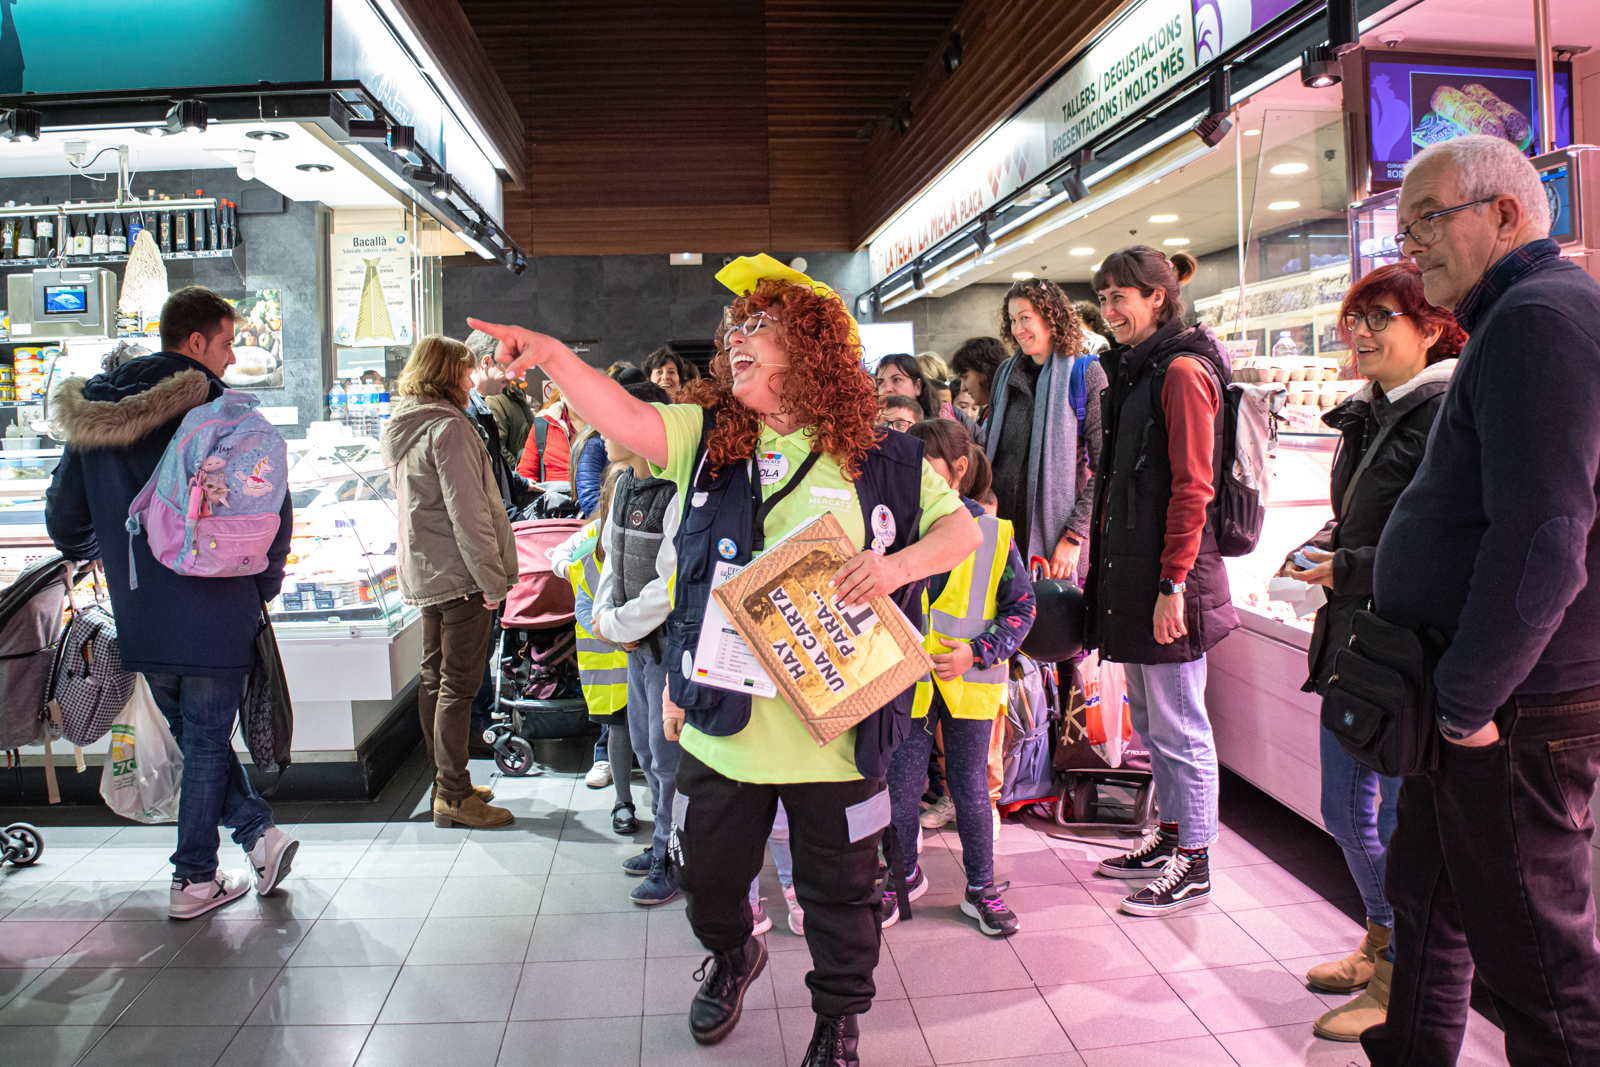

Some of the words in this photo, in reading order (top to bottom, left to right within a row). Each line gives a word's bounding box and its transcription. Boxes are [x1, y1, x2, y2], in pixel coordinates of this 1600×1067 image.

[1062, 82, 1096, 123] TALLERS
[1104, 14, 1182, 92] DEGUSTACIONS
[1053, 95, 1118, 158] PRESENTACIONS
[1125, 66, 1159, 108] MOLTS
[1161, 47, 1185, 83] MÉS
[353, 235, 387, 247] Bacallà
[885, 246, 894, 275] LA
[894, 232, 913, 266] TECA
[918, 219, 929, 252] LA
[930, 198, 958, 243] MECA
[960, 187, 984, 222] PLAÇA
[809, 497, 852, 509] MERCATS
[772, 587, 817, 650] CARTA
[772, 641, 807, 680] HAY
[814, 651, 845, 692] UNA
